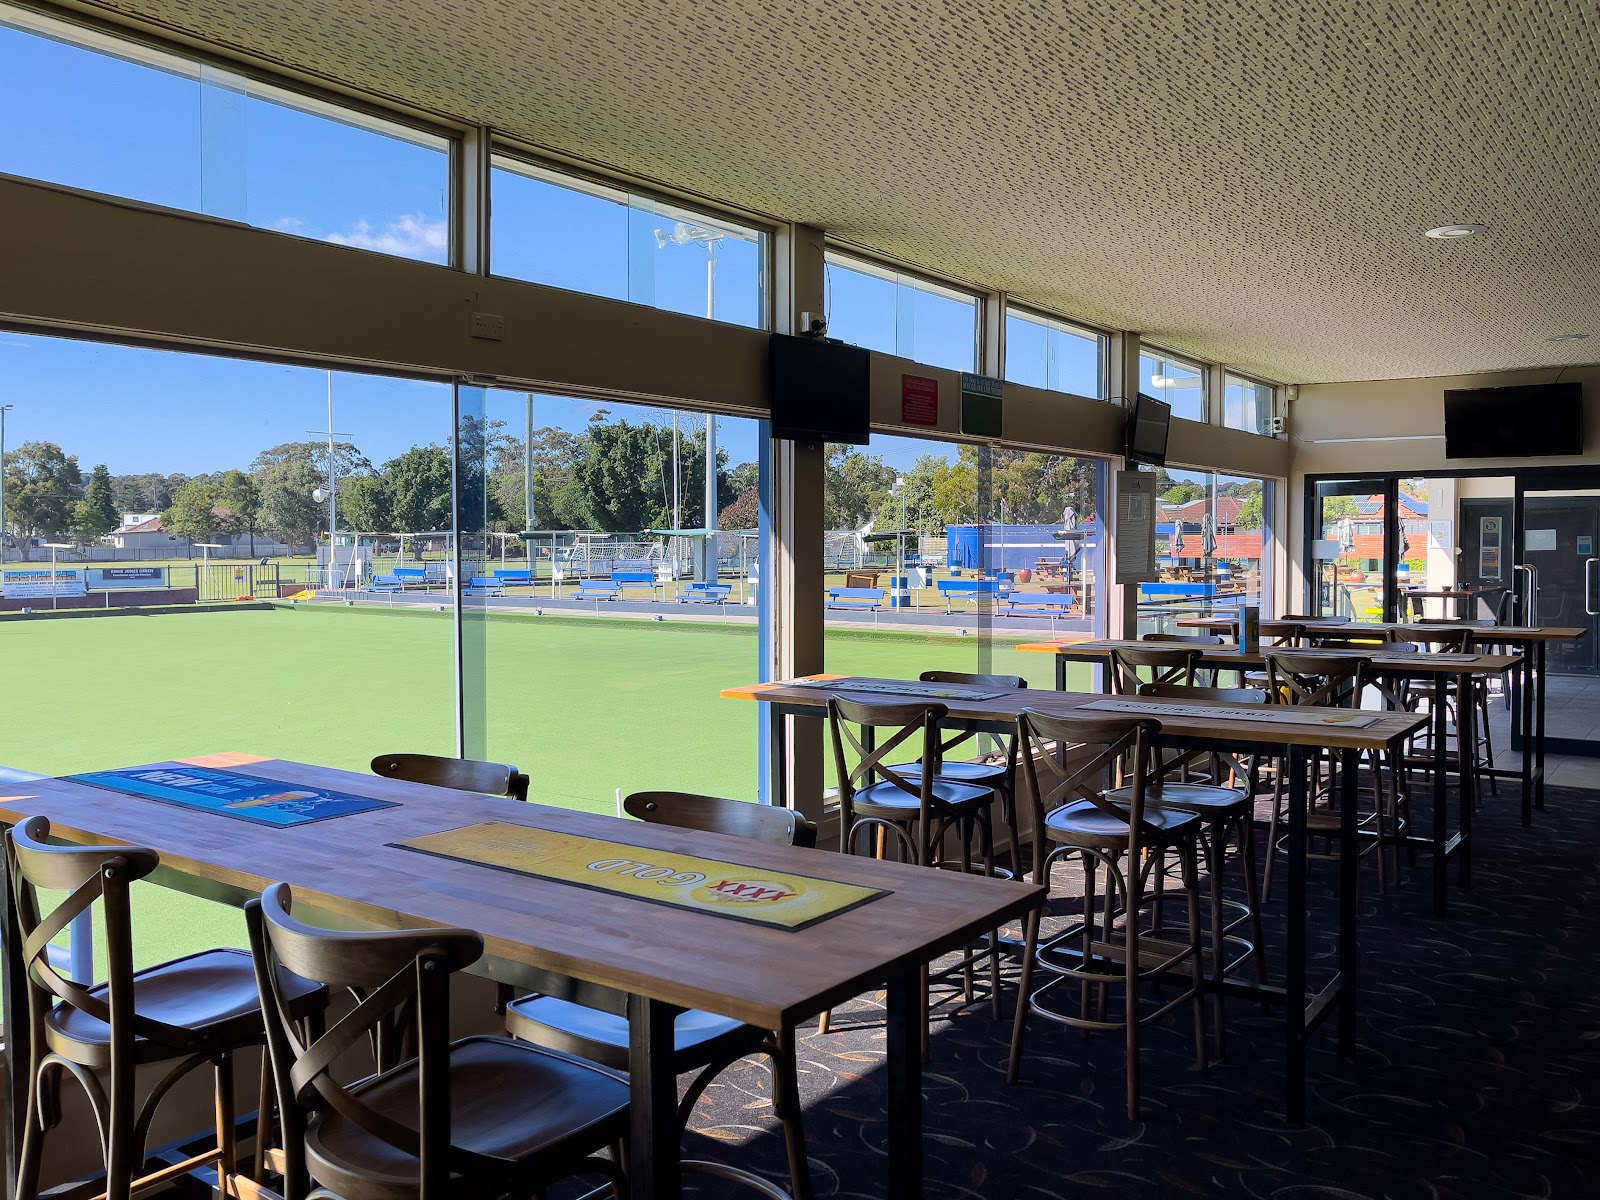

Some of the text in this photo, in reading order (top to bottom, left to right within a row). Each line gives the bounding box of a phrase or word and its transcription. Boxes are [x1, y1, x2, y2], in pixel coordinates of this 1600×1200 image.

[130, 770, 213, 787] NEW
[587, 859, 799, 901] XXXX GOLD
